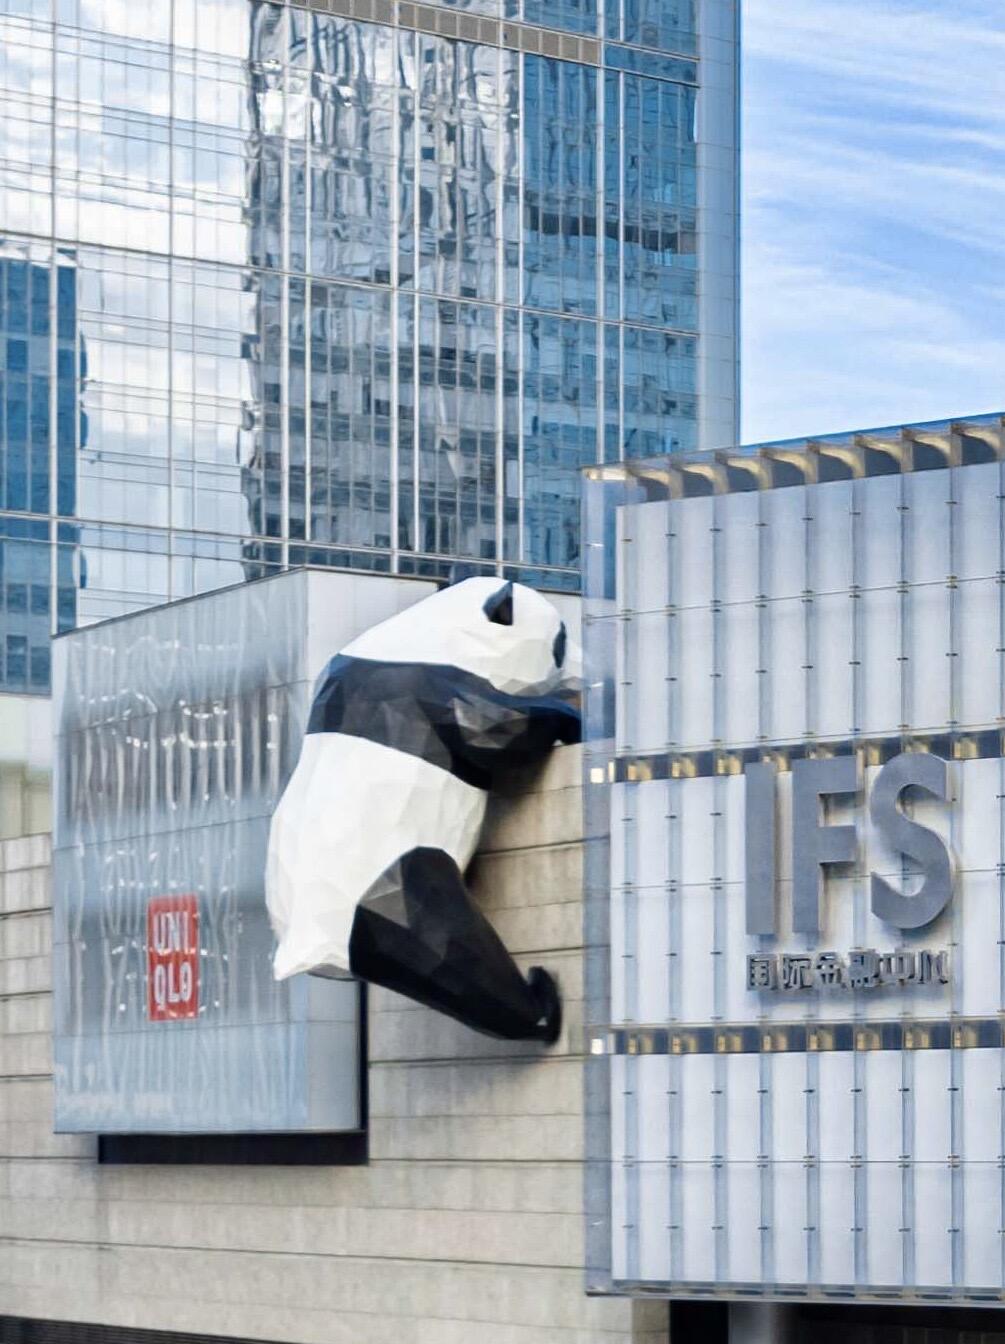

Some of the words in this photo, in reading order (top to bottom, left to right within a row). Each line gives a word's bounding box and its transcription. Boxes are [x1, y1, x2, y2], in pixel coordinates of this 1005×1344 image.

[745, 752, 955, 936] IFS
[153, 910, 190, 956] UNI
[154, 962, 192, 1010] QLO
